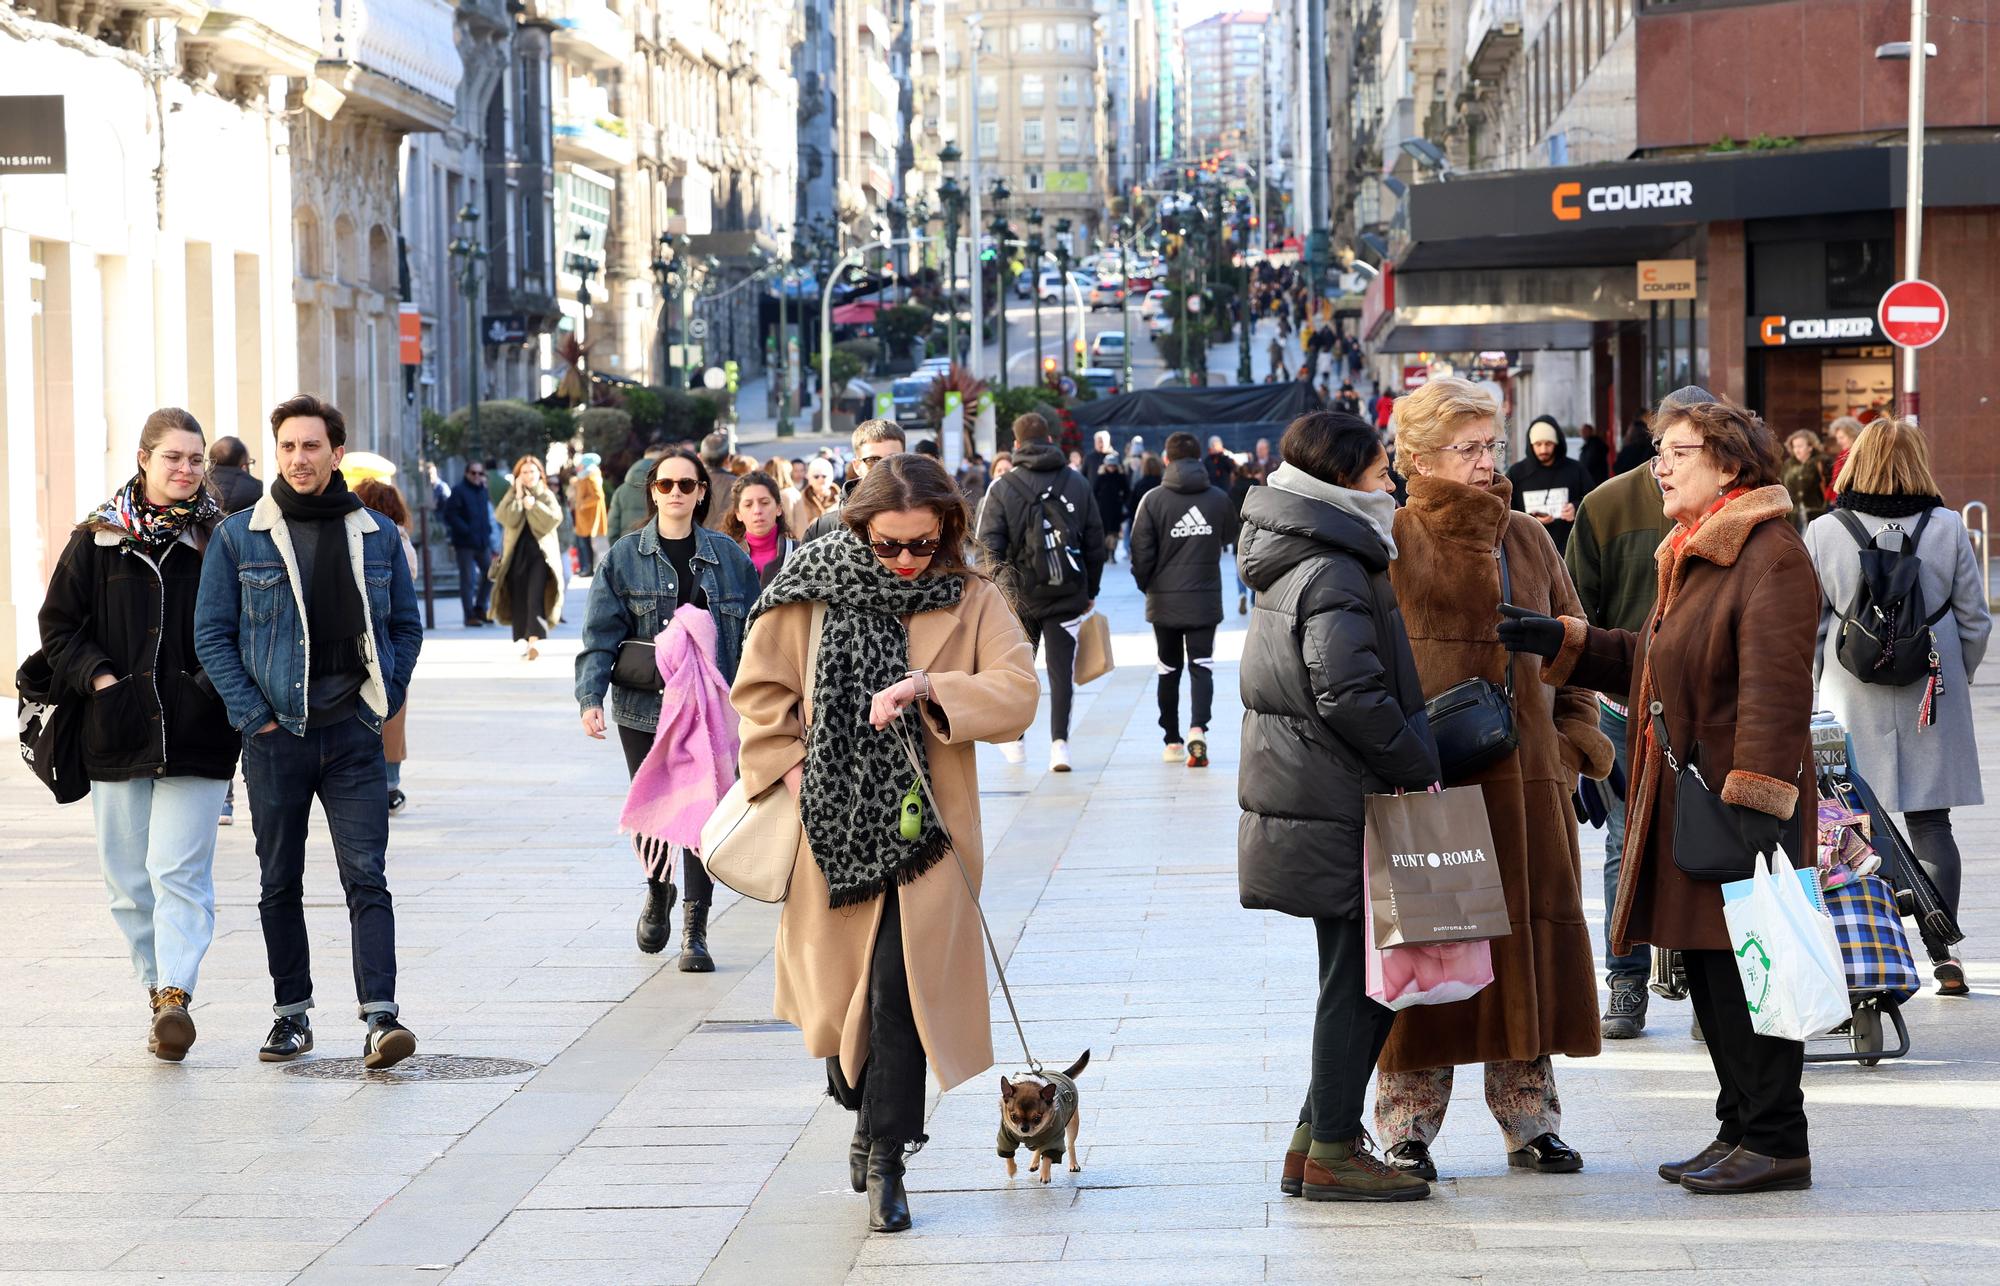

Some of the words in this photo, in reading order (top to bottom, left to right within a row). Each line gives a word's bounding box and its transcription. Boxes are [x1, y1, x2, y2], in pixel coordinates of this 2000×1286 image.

[1588, 181, 1693, 212] COURIR
[1643, 282, 1691, 291] COURIR
[1789, 317, 1874, 339] COURIR
[1170, 524, 1213, 538] adidas
[1392, 853, 1425, 868] PUNT
[1442, 848, 1487, 866] ROMA
[1433, 924, 1478, 933] puntroma.com
